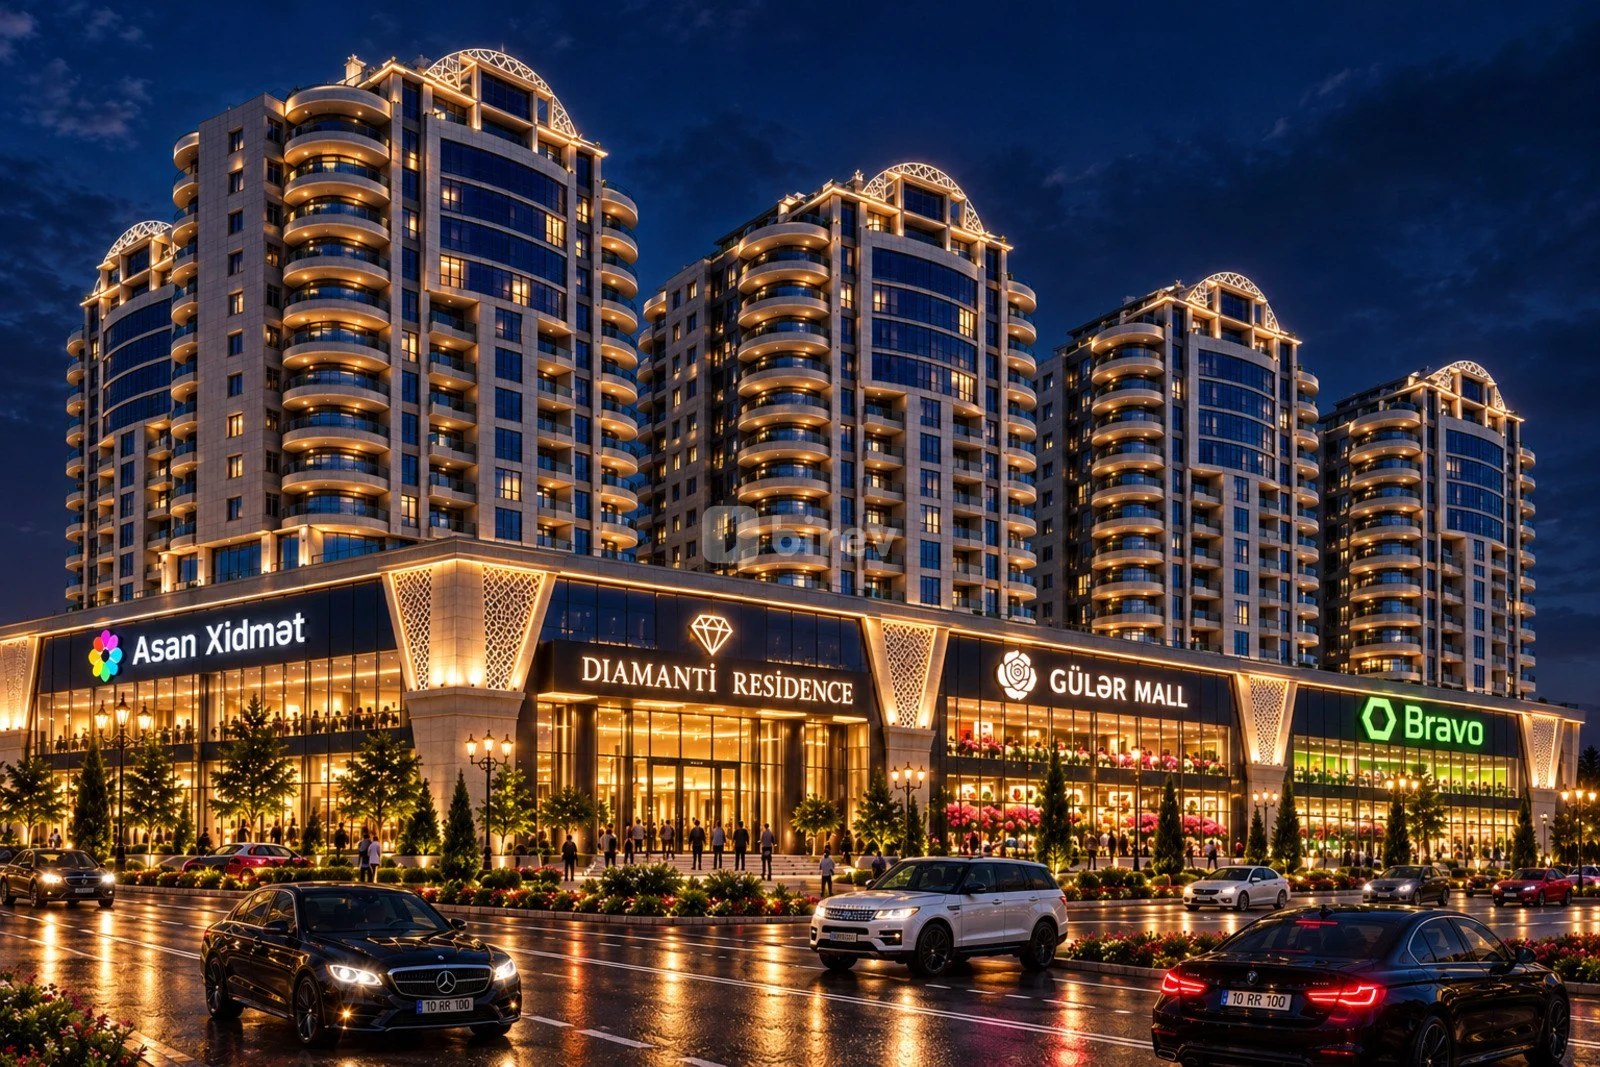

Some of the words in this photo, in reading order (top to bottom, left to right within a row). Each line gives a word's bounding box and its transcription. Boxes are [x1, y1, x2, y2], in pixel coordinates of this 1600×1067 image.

[132, 634, 196, 665] Asan
[205, 612, 305, 655] Xidmət
[733, 670, 853, 704] RESİDENCE
[1134, 680, 1188, 708] MALL
[1405, 705, 1483, 745] Bravo
[426, 1001, 436, 1011] 10
[454, 999, 470, 1010] 100
[1232, 993, 1243, 1004] 10
[1247, 994, 1262, 1006] RR
[1266, 995, 1286, 1008] 100
